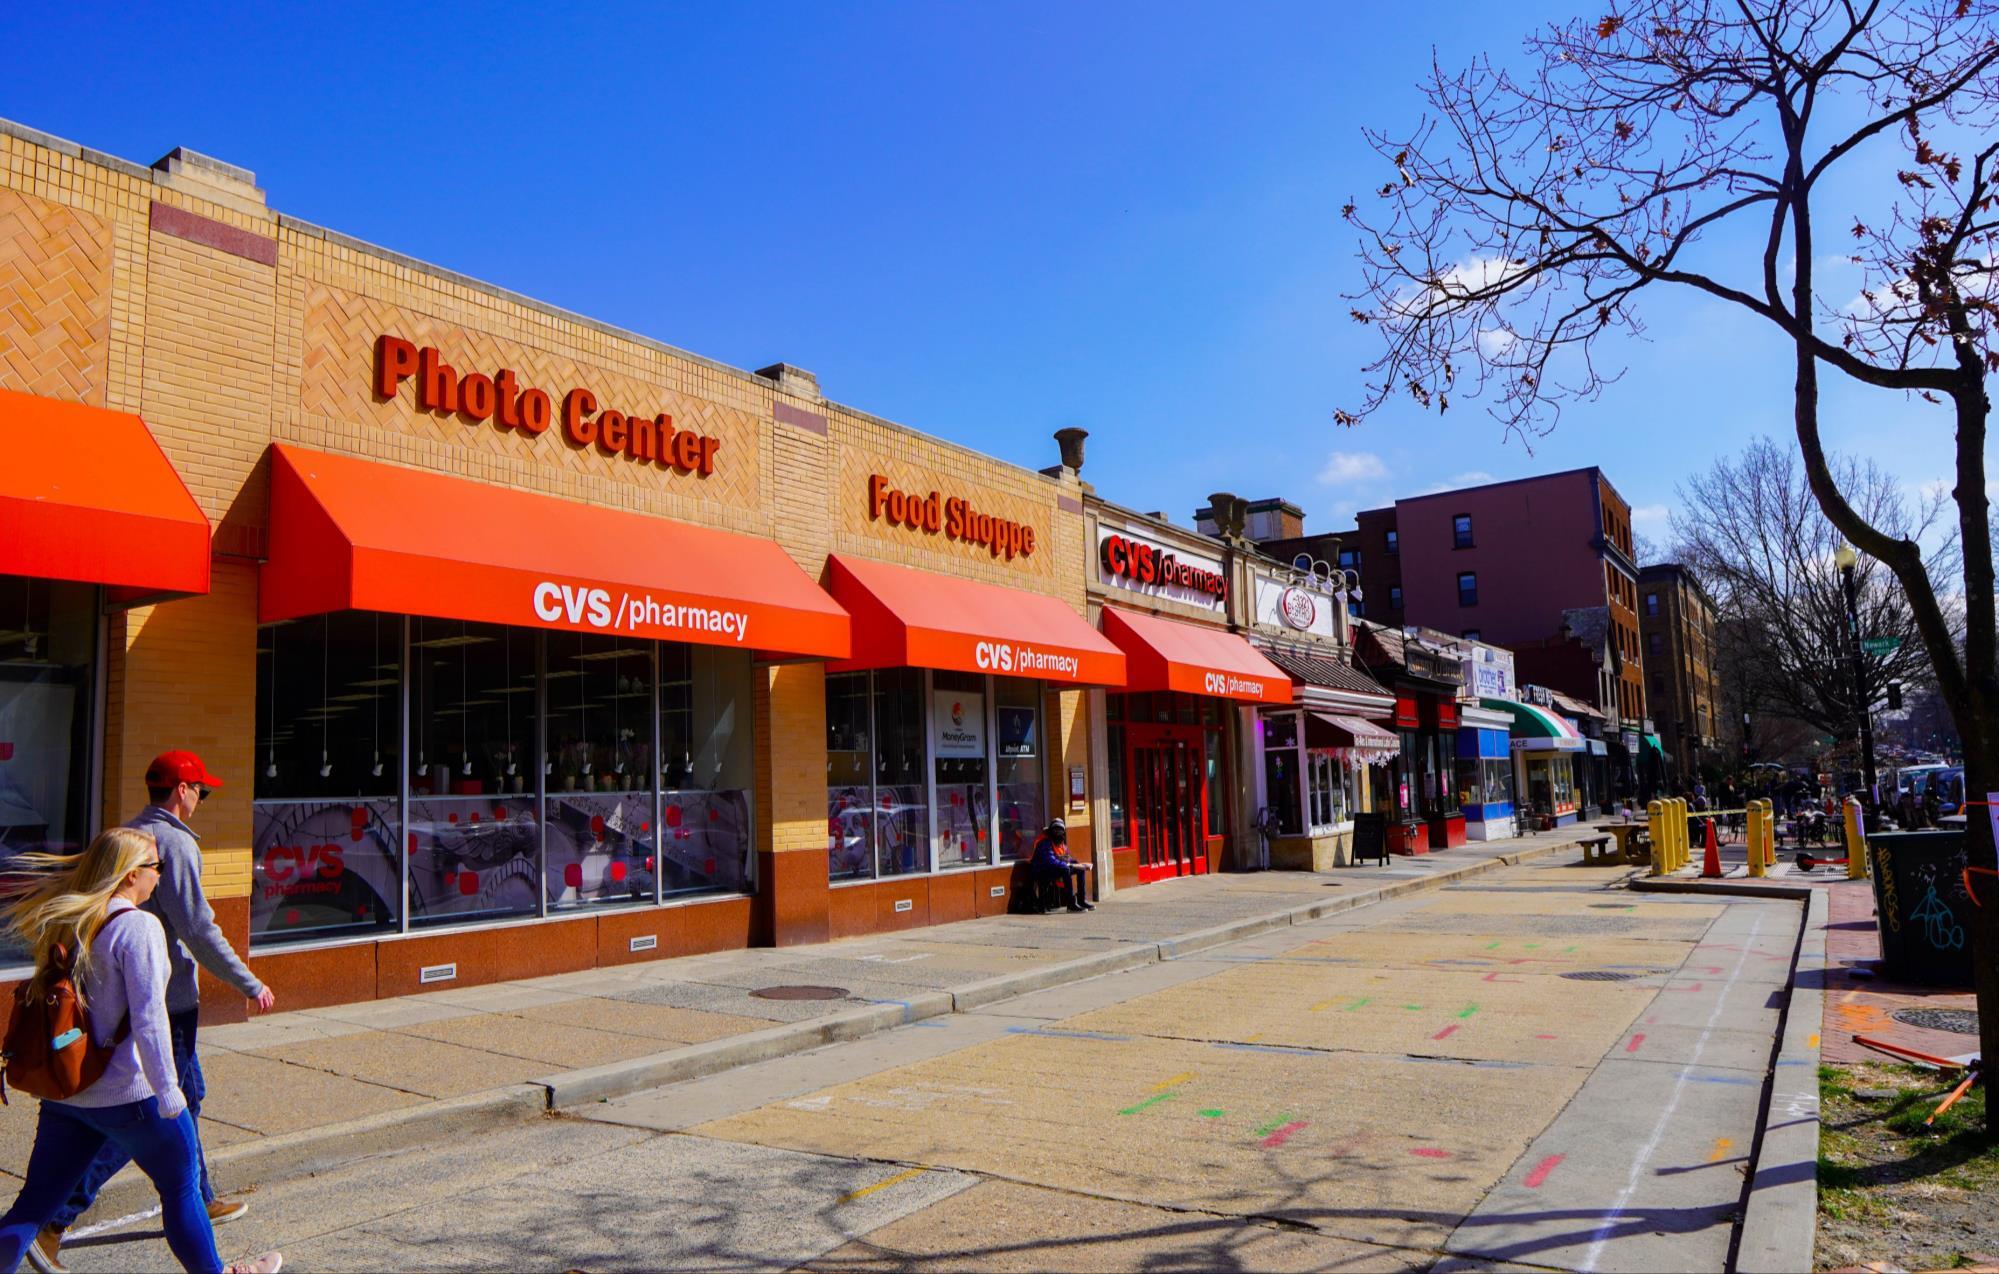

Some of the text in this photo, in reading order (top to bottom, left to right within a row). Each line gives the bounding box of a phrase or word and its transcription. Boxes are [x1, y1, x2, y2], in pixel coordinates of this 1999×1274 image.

[375, 334, 720, 475] Photo Center
[869, 474, 1036, 560] Food Shoppe
[263, 843, 345, 881] CVS
[263, 881, 342, 902] pharmacy
